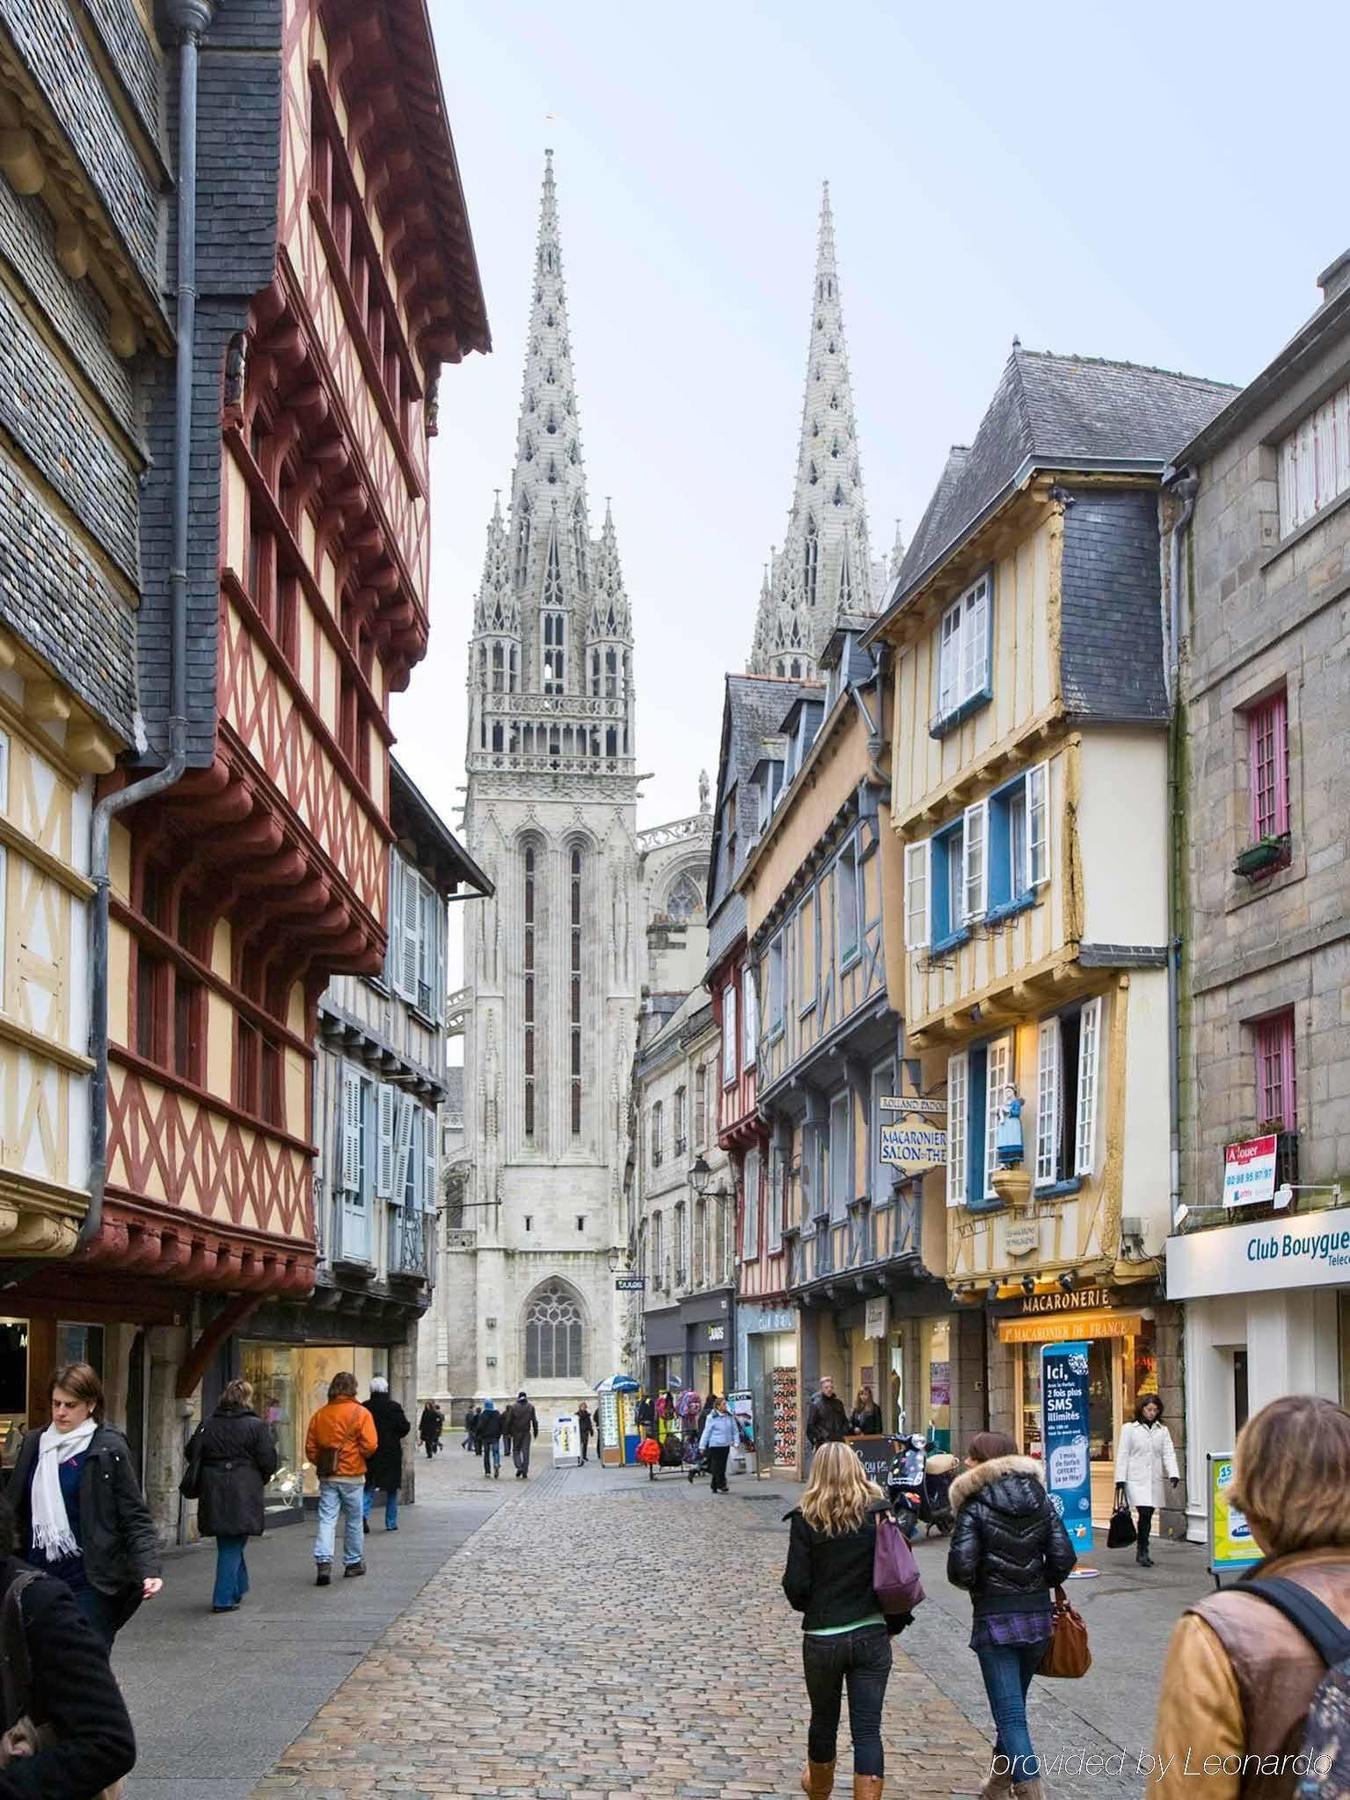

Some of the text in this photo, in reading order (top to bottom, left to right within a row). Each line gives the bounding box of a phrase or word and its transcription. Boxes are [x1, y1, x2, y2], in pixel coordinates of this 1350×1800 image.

[882, 1145, 921, 1161] SALON
[1247, 1237, 1279, 1261] Club
[1022, 1289, 1110, 1312] MACARONERIE
[1090, 1321, 1127, 1337] FRANCE
[1047, 1364, 1069, 1380] Ici,
[1047, 1387, 1083, 1399] 2 fois plus
[1047, 1398, 1073, 1412] SMS
[1047, 1410, 1080, 1422] illimités
